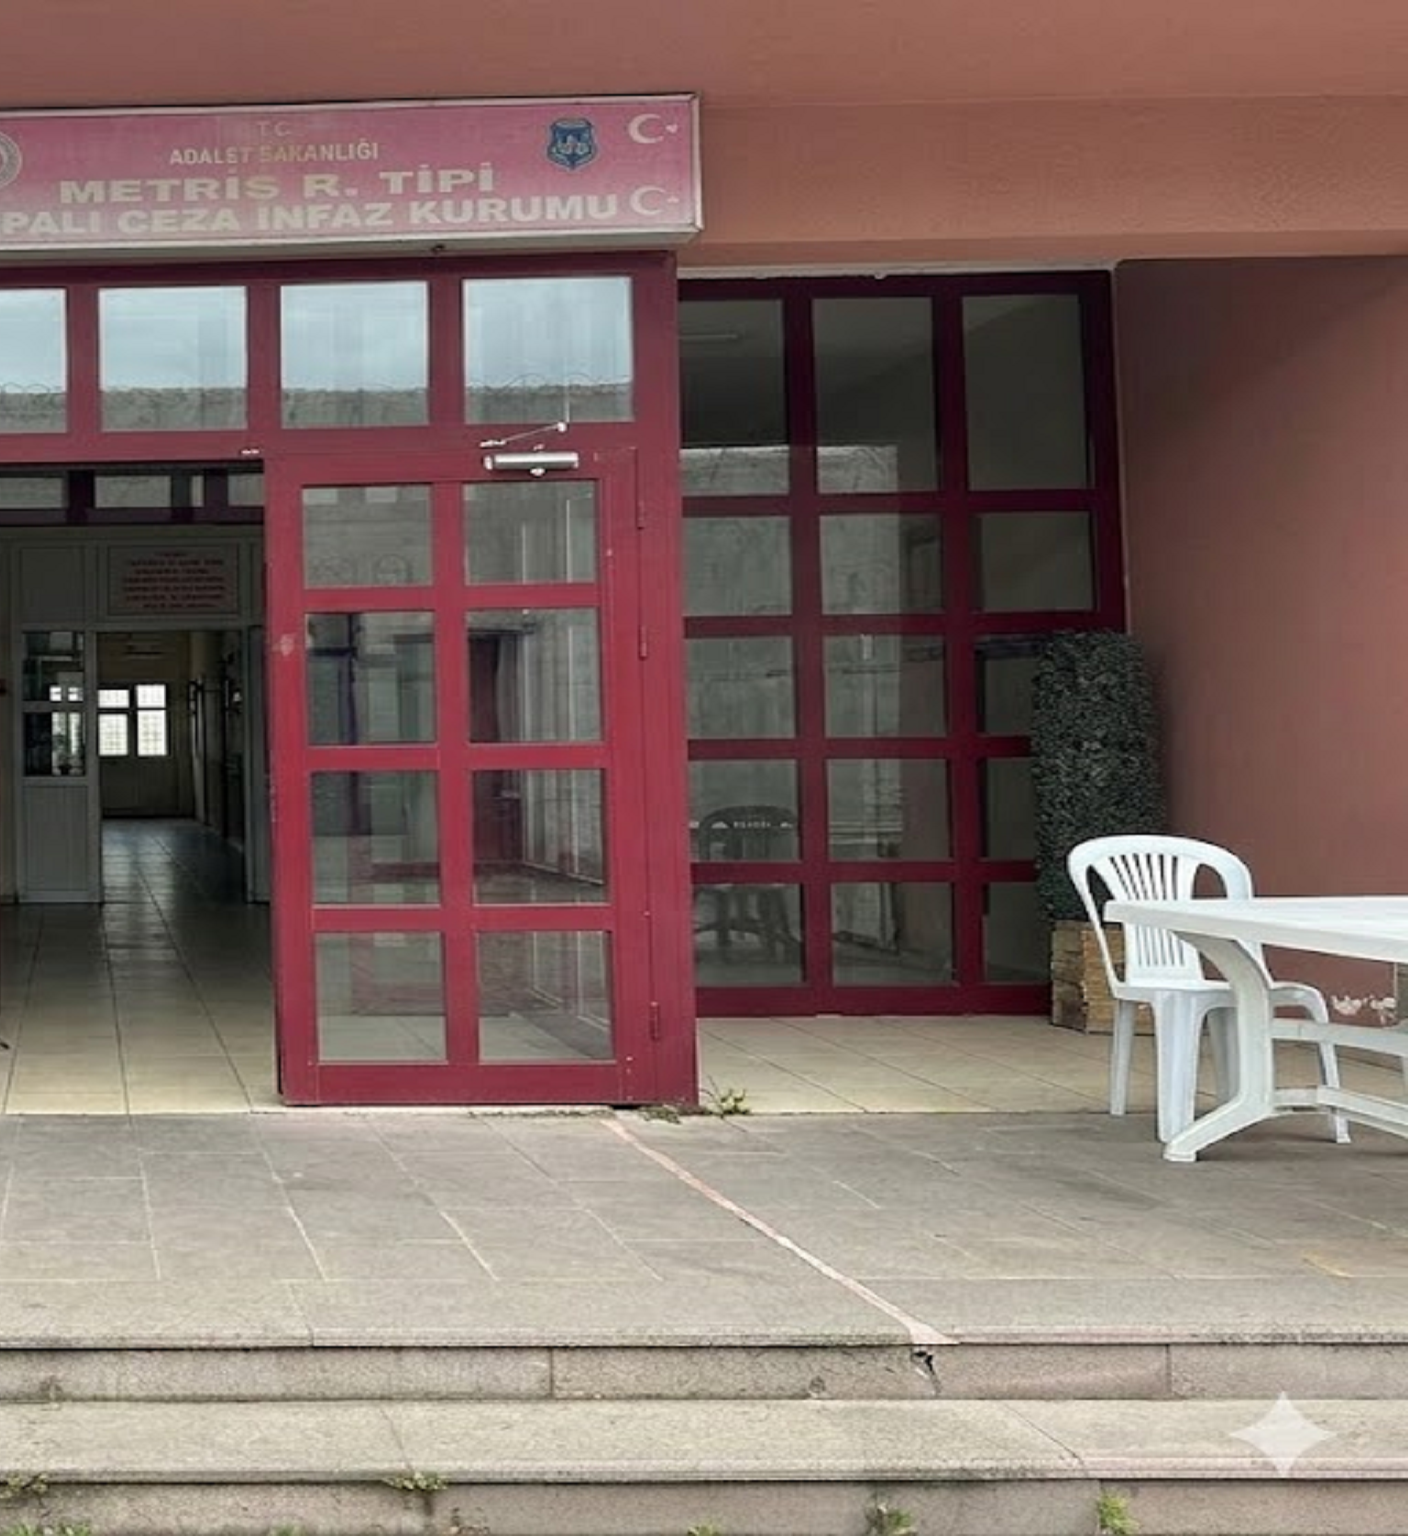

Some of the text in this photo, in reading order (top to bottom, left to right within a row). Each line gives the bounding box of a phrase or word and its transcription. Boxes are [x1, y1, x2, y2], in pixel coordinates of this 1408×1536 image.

[60, 162, 493, 203] METRİS R. TİPİ
[117, 207, 241, 234] CEZA
[409, 194, 617, 225] KURUMU
